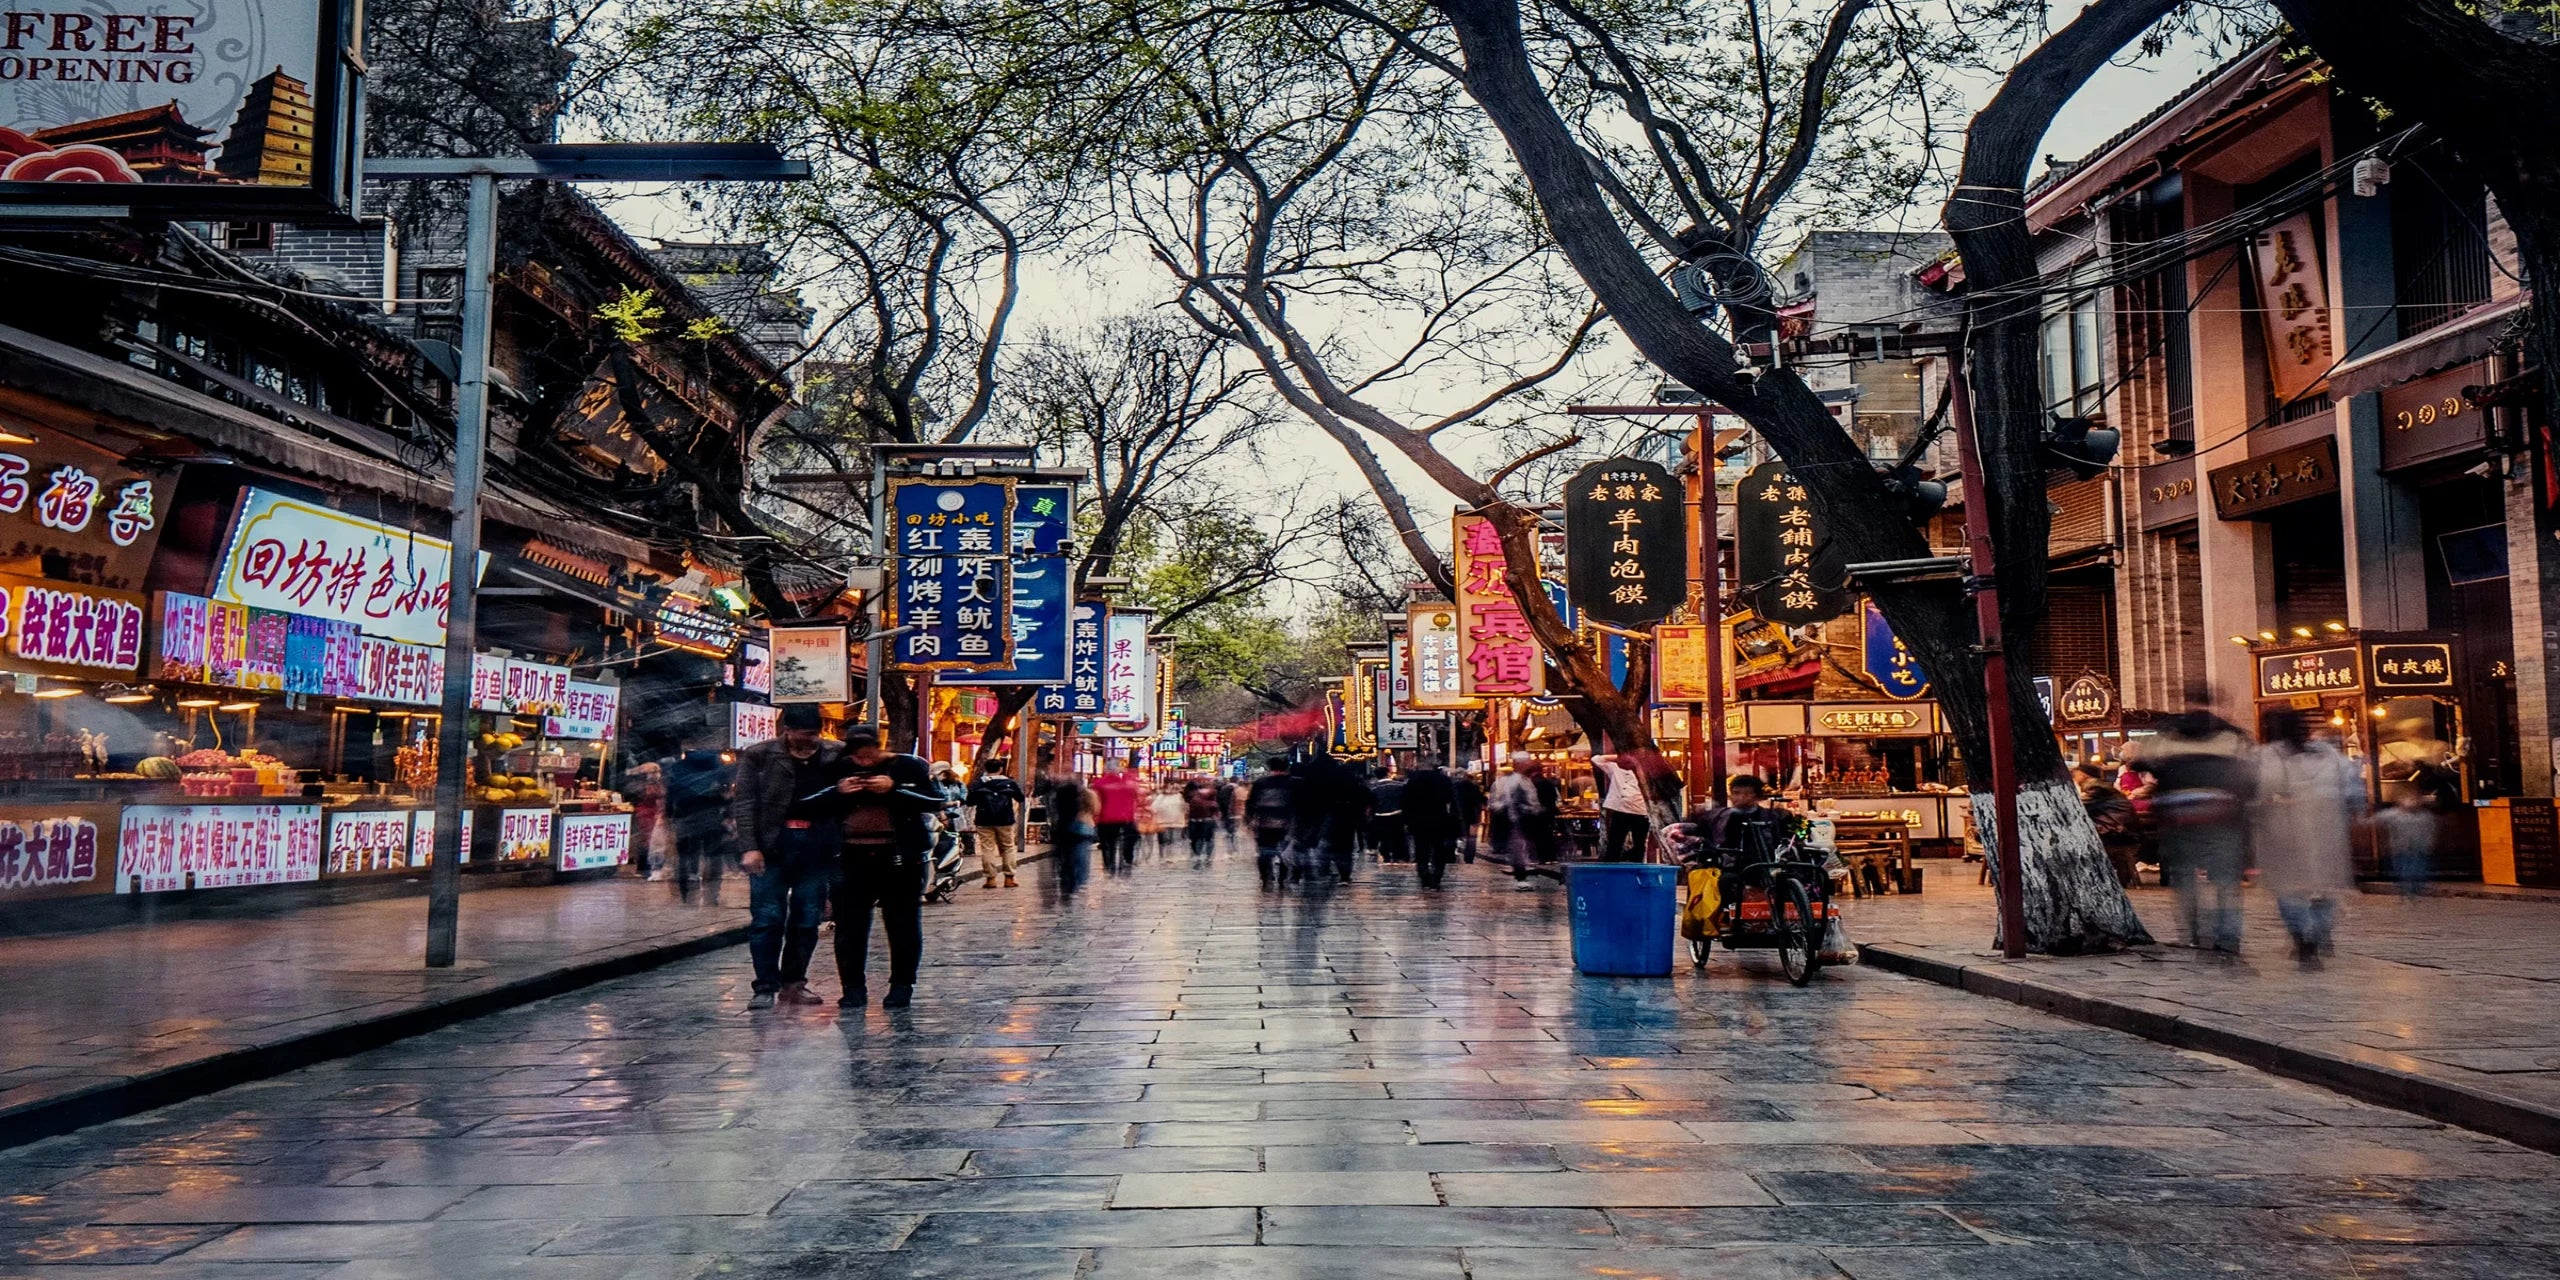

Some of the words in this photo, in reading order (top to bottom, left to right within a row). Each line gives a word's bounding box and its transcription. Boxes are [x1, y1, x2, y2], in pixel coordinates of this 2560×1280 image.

[3, 12, 195, 54] FREE
[0, 57, 194, 84] OPENING
[906, 512, 995, 527] 回坊小吃
[907, 527, 943, 656] 红柳烤羊肉
[956, 527, 993, 656] 轰炸大鱿鱼
[21, 589, 142, 668] 铁板大鱿鱼
[803, 638, 829, 648] 中国
[1074, 621, 1099, 710] 轰炸大鱿鱼
[1108, 638, 1136, 703] 果仁酥
[508, 666, 566, 704] 现切水果
[334, 820, 404, 853] 红柳烤肉
[504, 814, 549, 841] 现切水果
[565, 821, 628, 852] 鲜榨石榴汁
